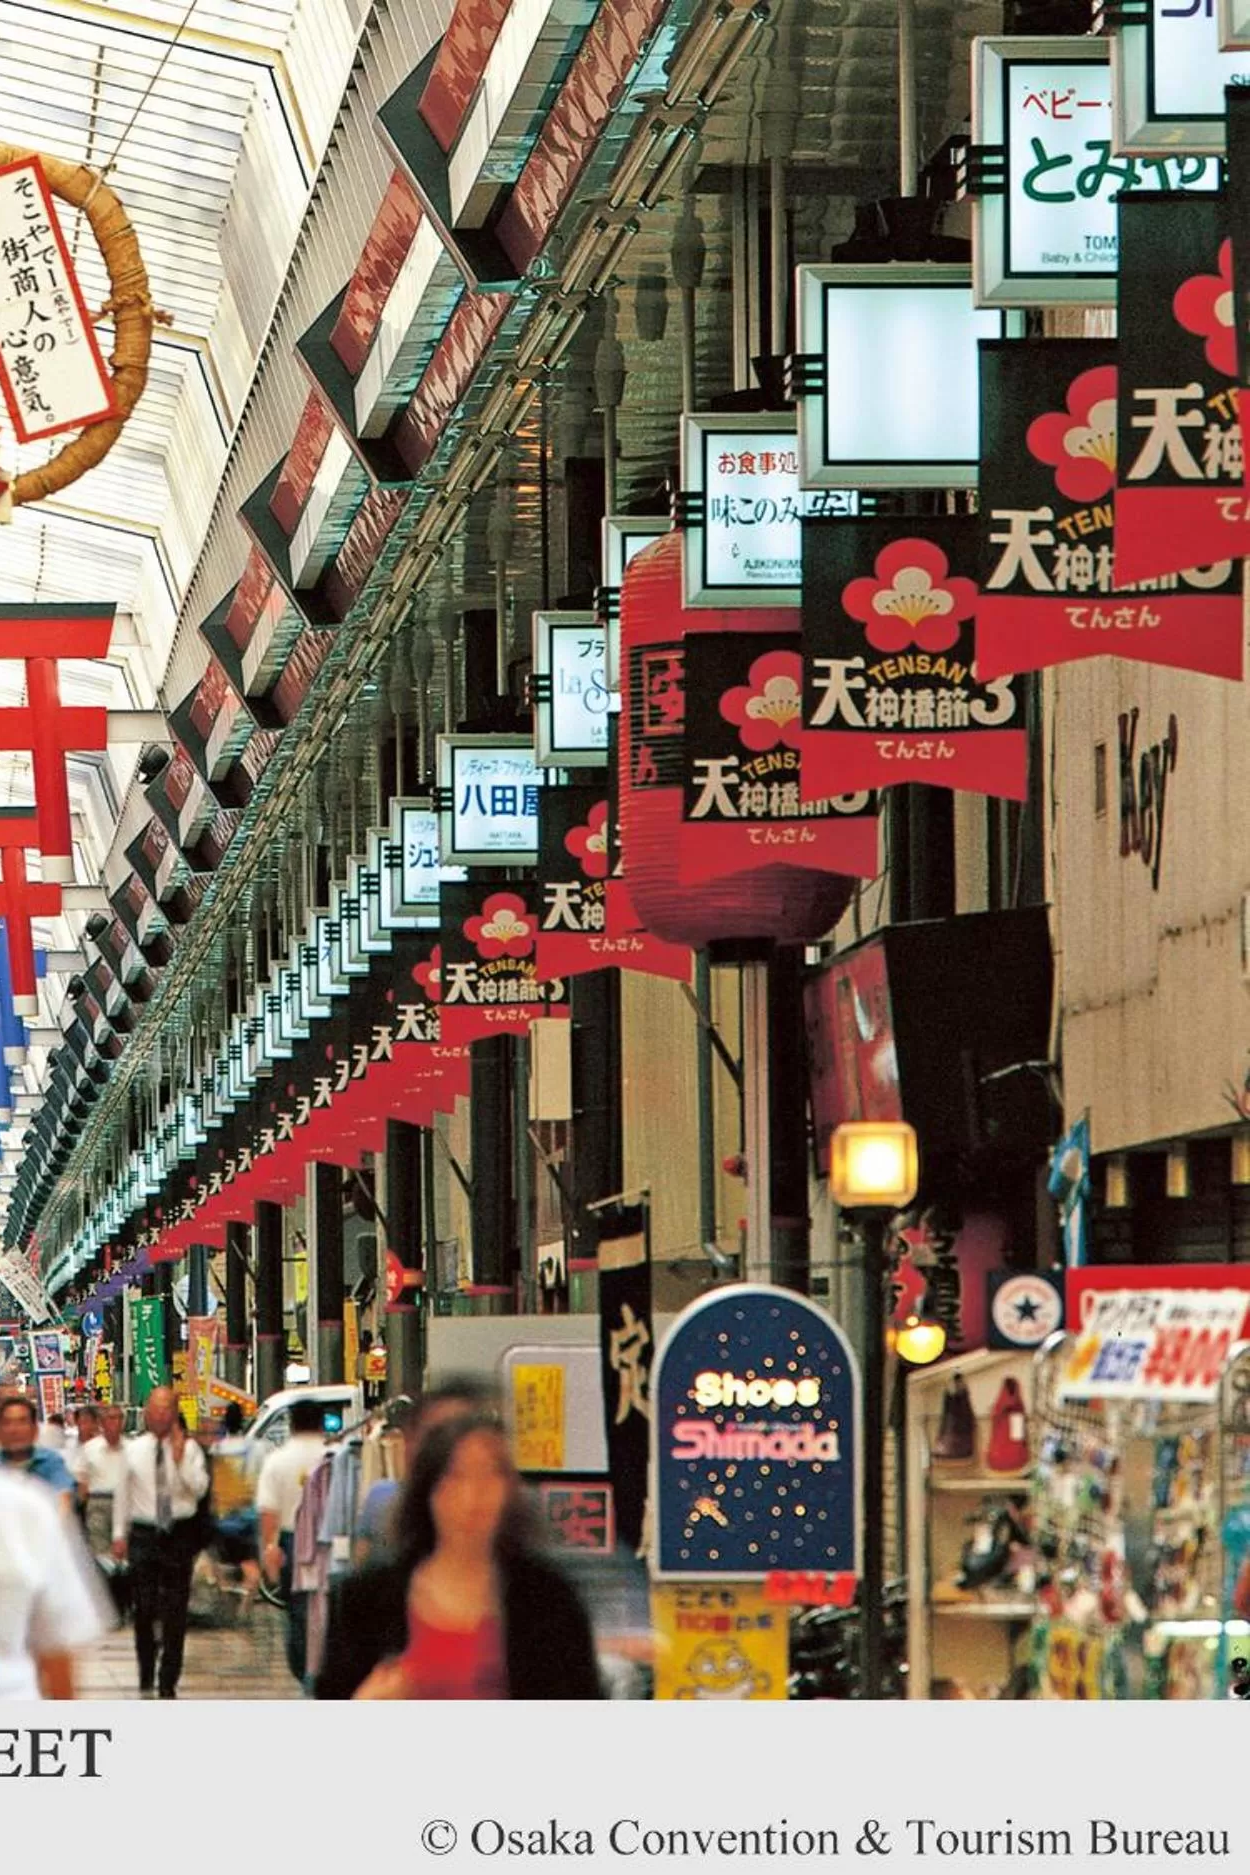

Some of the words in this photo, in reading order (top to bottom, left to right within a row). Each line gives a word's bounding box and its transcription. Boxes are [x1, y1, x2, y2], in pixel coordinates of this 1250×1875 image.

[1041, 252, 1071, 265] Baby
[718, 451, 799, 476] お食事処
[1064, 605, 1162, 630] てんさん
[866, 654, 969, 685] TENSAN
[875, 739, 956, 760] てんさん
[746, 826, 817, 845] てんさん
[587, 937, 644, 953] てんさん
[482, 1008, 531, 1022] てんさん
[694, 1371, 821, 1408] Shoes
